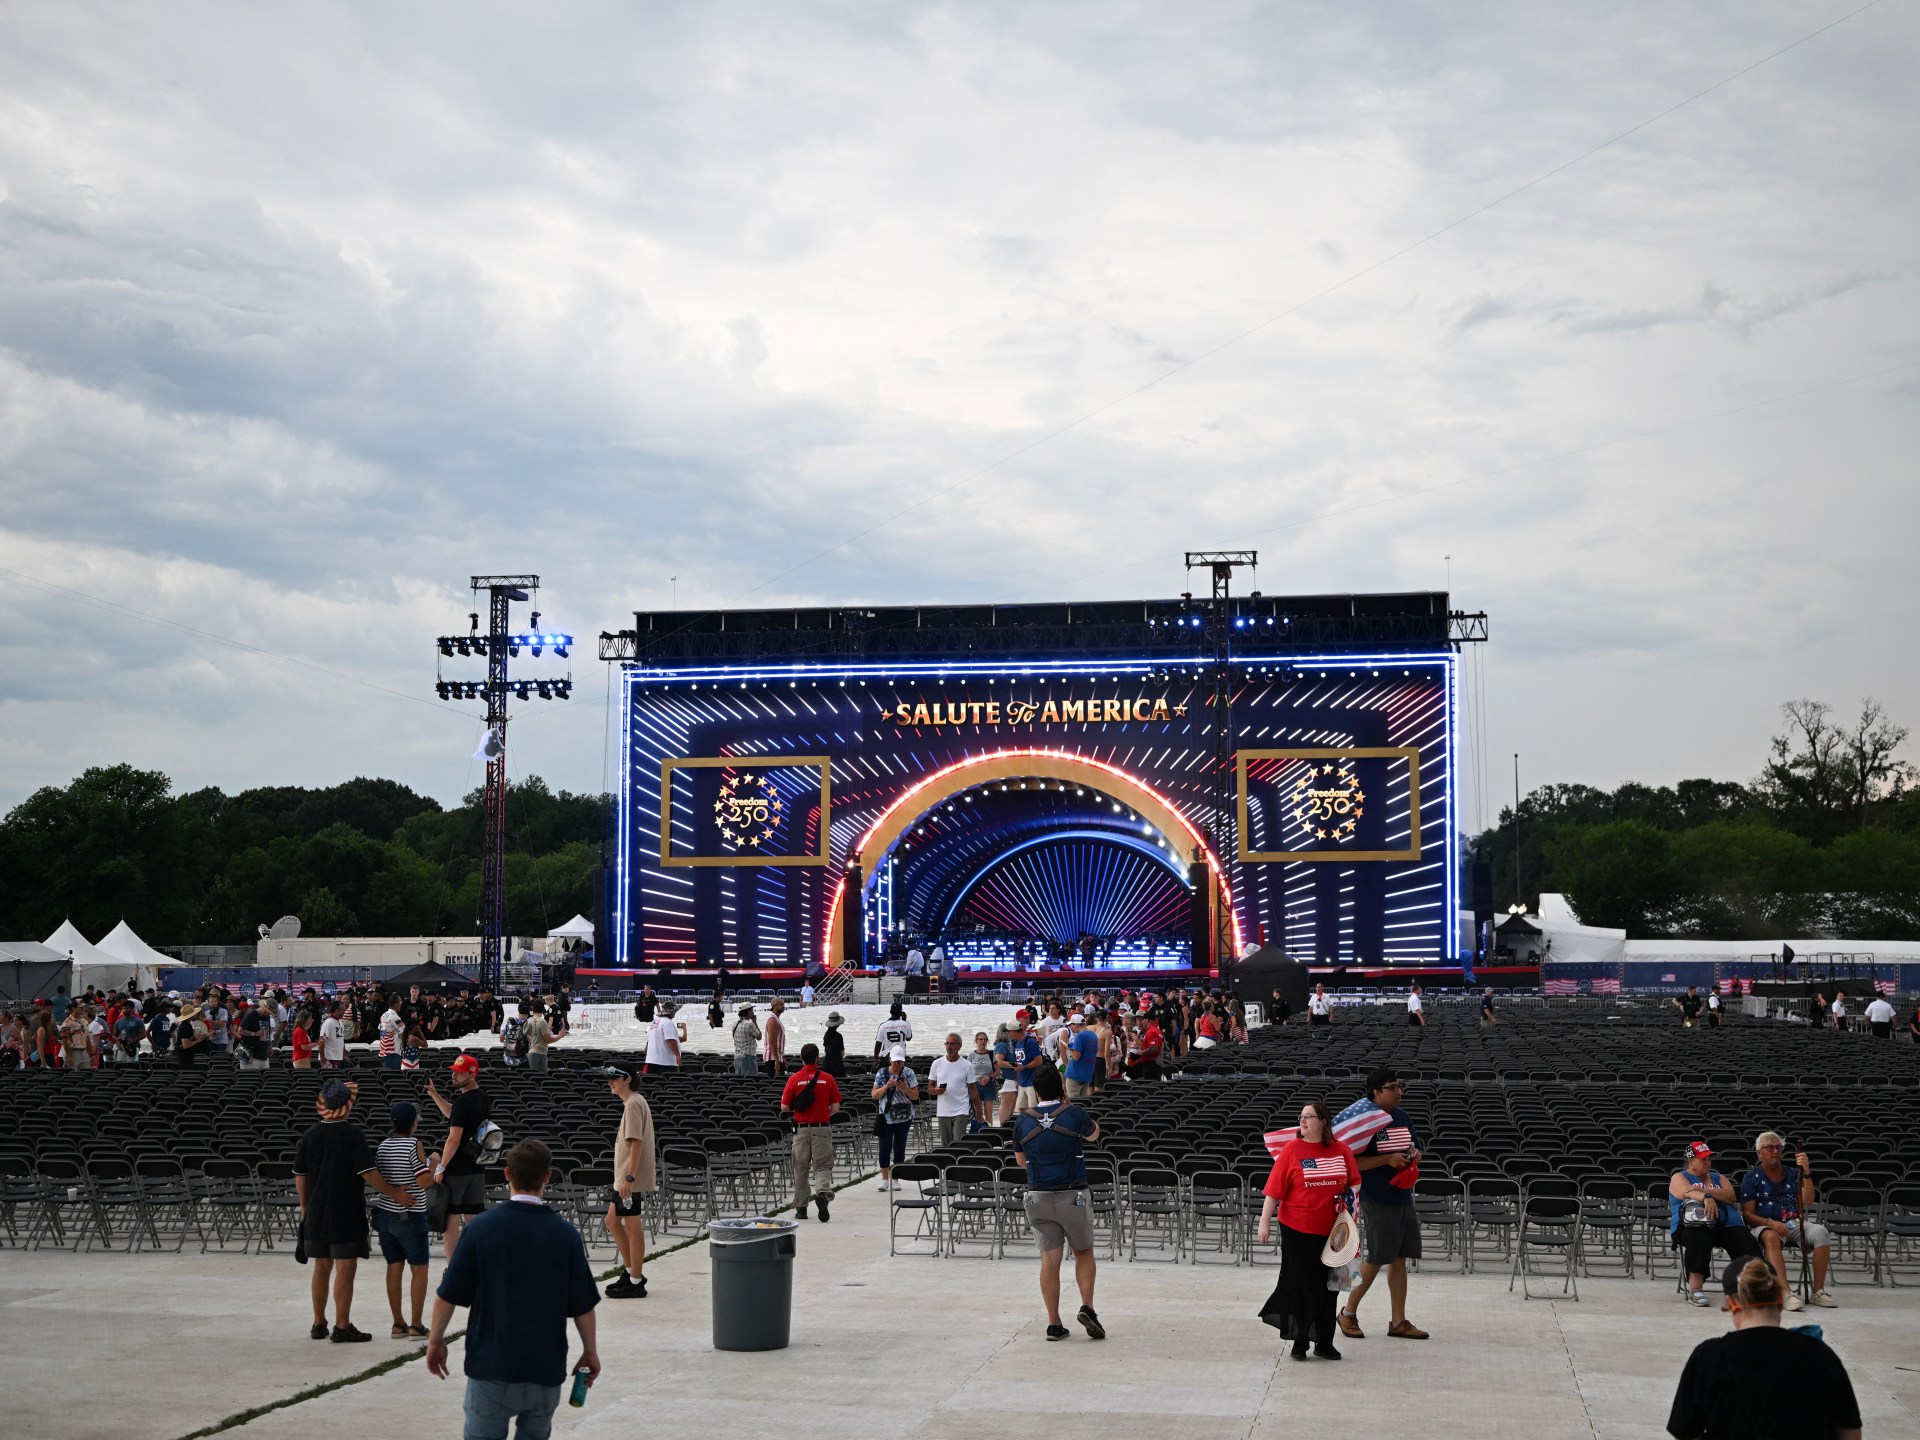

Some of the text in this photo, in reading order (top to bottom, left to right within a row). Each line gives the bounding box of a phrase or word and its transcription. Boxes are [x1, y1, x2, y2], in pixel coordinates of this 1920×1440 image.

[896, 698, 1172, 726] SALUTE To AMERICA
[1307, 788, 1350, 798] Freedom
[728, 797, 769, 806] Freedom
[1307, 797, 1350, 821] 250
[728, 806, 769, 828] 250
[1304, 1180, 1337, 1188] Freedom
